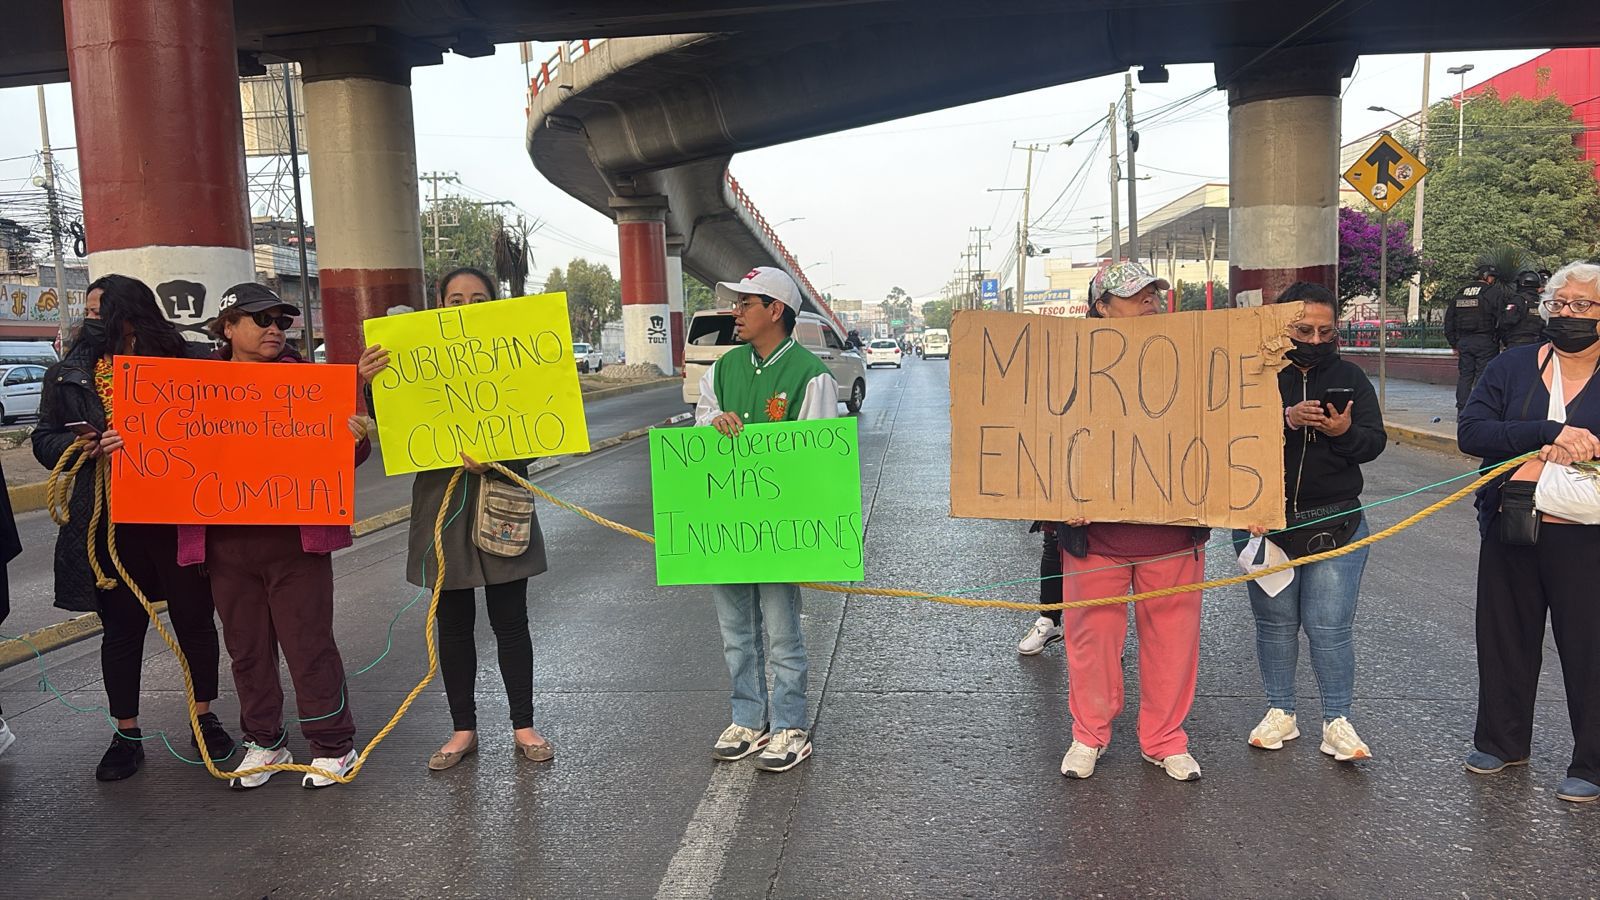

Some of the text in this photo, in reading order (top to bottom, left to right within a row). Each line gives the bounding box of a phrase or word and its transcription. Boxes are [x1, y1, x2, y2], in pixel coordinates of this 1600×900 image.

[437, 310, 479, 340] EL
[1038, 306, 1065, 316] TESCO
[382, 331, 563, 389] SUBURBANO
[982, 322, 1263, 418] MURO DE
[274, 383, 324, 417] que
[445, 381, 498, 413] NO
[124, 407, 333, 441] el Gobierno Federal
[408, 395, 565, 467] CUMPLIÓ
[119, 443, 196, 479] NOS
[717, 427, 850, 467] queremos
[707, 462, 781, 499] MÁS
[979, 426, 1263, 510] ENCINOS
[192, 472, 347, 516] CUMPLA!
[657, 511, 861, 568] INUNDACIONES
